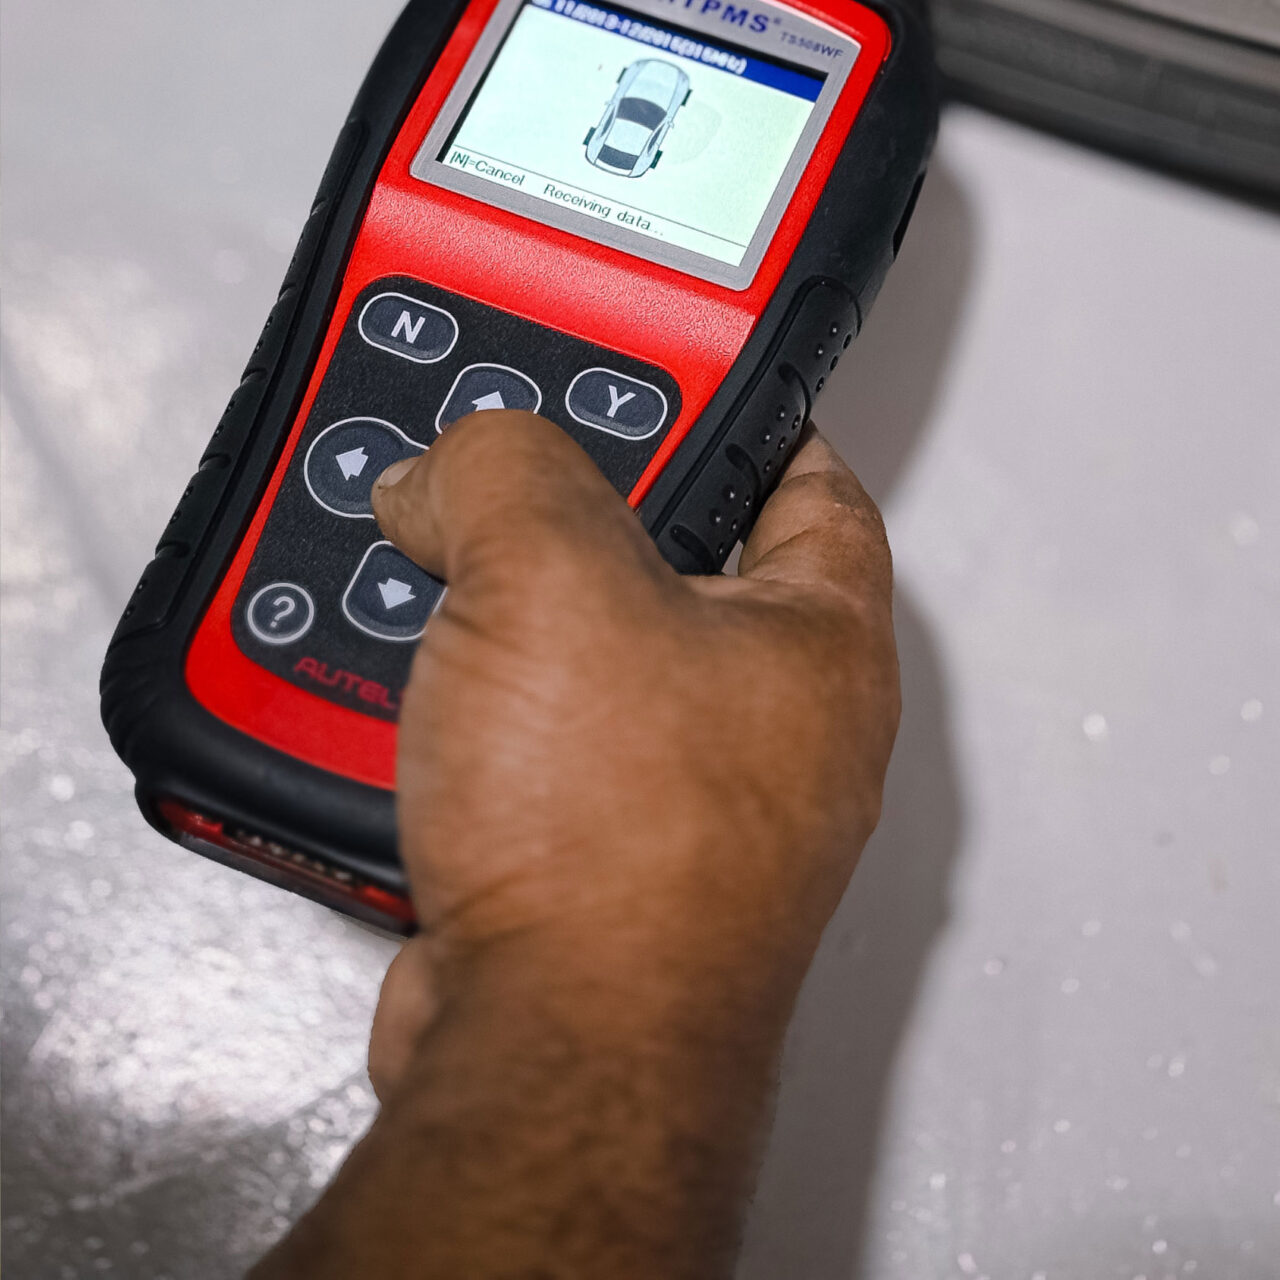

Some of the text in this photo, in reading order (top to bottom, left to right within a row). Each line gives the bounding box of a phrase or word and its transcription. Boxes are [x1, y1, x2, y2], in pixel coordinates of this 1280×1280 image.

[543, 183, 611, 219] Receiving
[391, 311, 426, 344] N
[604, 385, 637, 419] Y
[270, 595, 296, 628] ?
